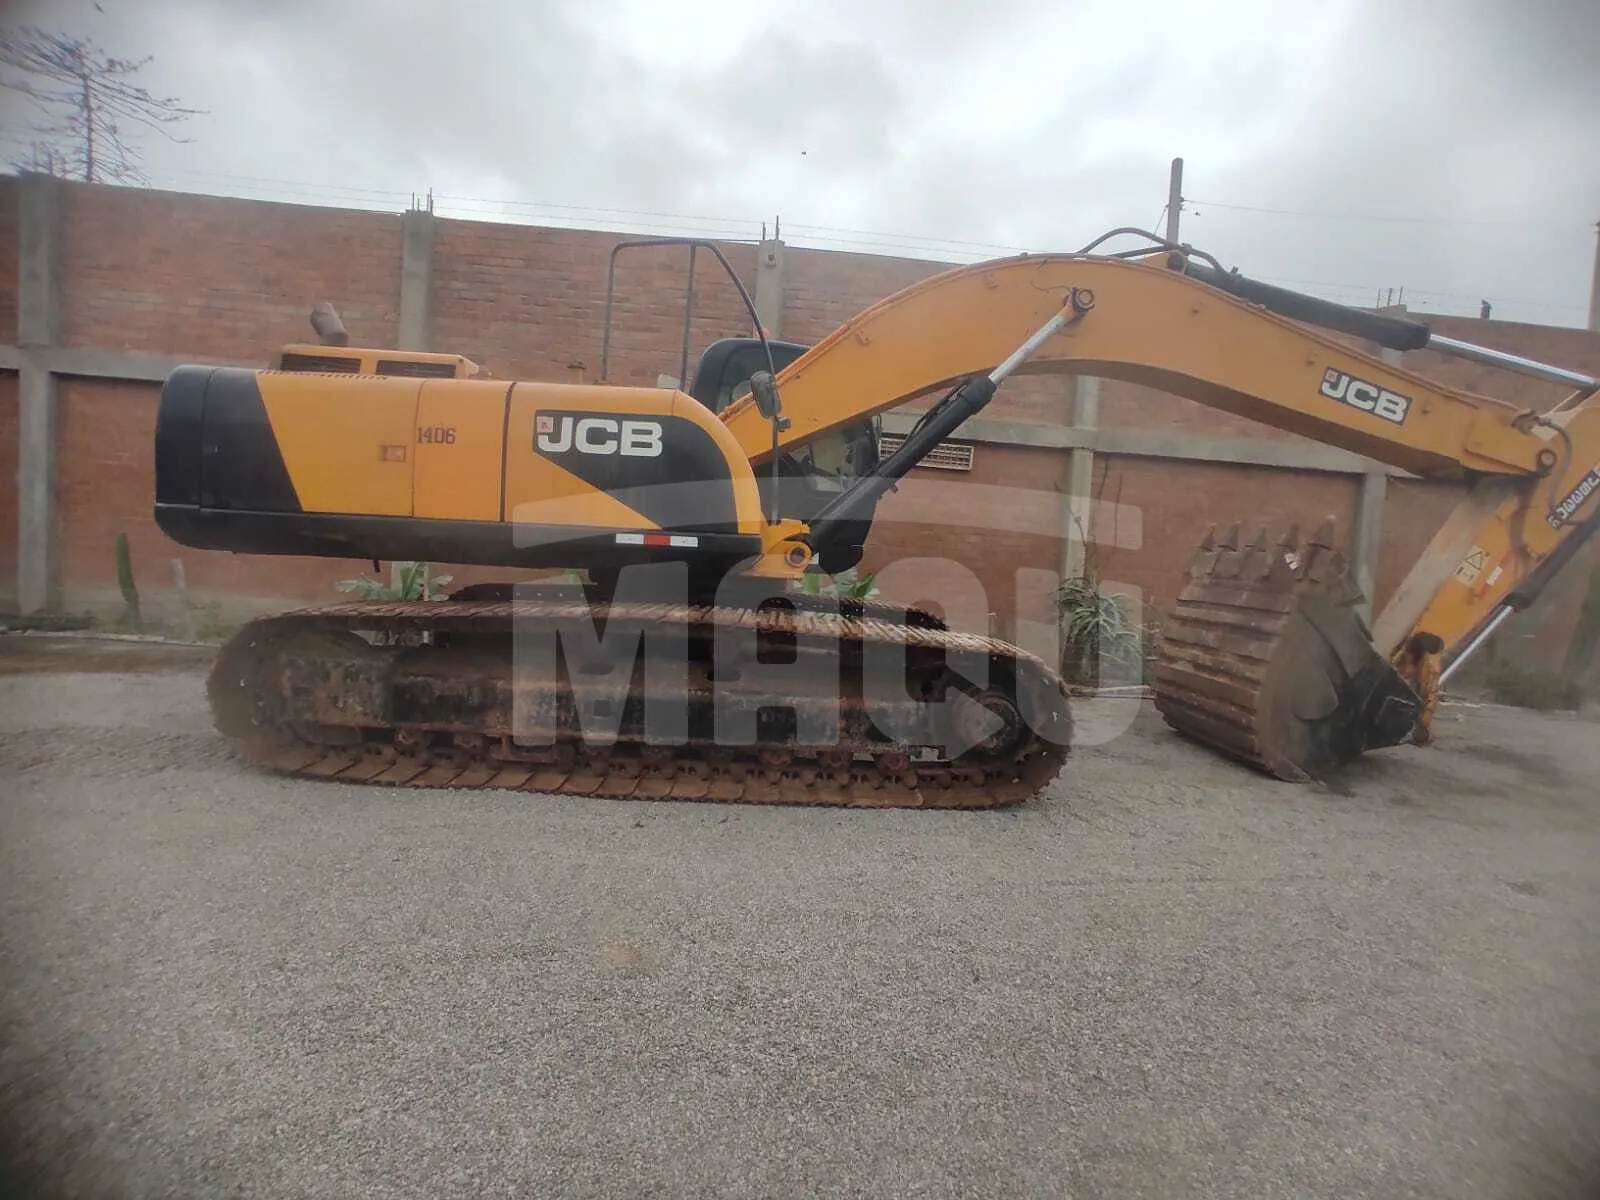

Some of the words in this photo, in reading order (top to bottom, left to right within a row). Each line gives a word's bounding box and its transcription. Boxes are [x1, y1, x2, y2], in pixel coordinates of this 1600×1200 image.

[1321, 370, 1408, 422] JCB
[417, 426, 456, 445] 1406
[536, 415, 663, 457] JCB
